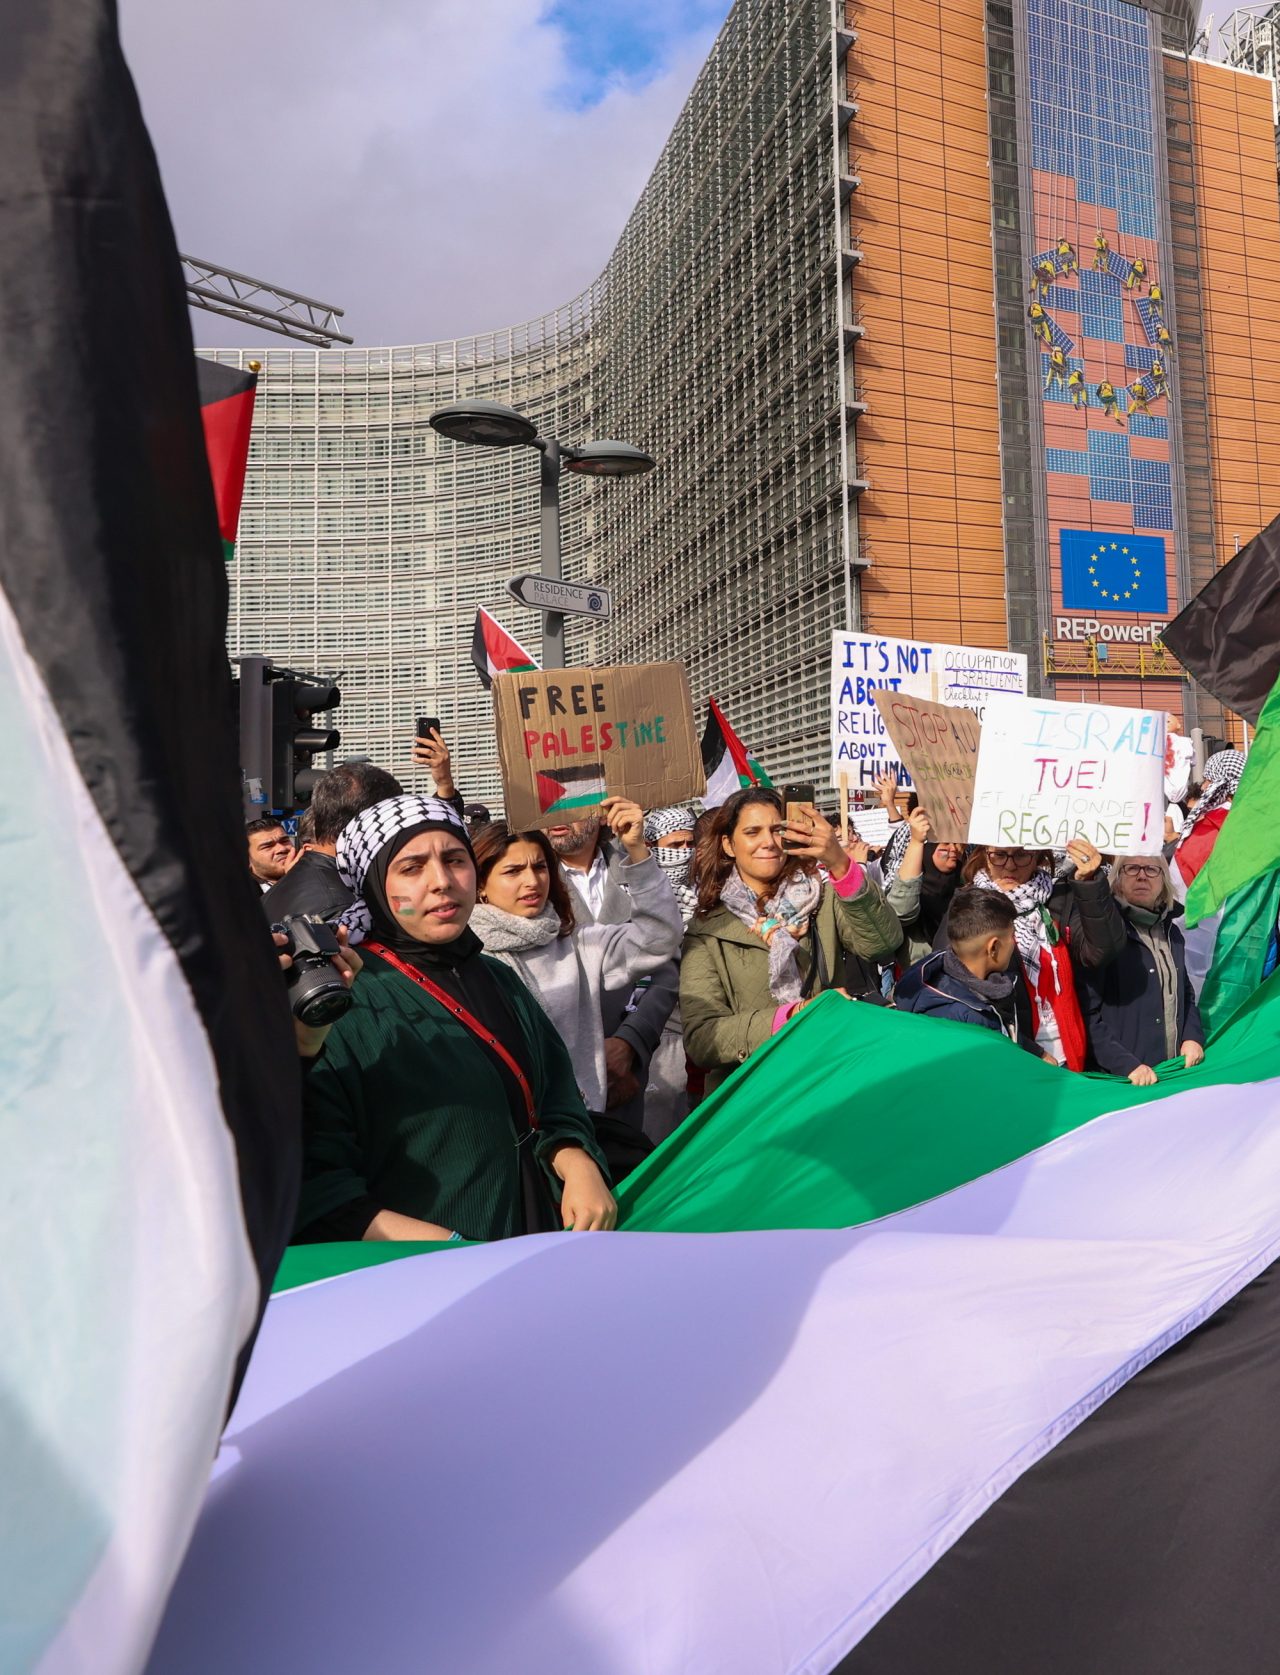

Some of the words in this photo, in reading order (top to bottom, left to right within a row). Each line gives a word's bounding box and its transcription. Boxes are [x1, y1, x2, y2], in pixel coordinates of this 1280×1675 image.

[533, 581, 583, 599] RESIDENCE
[534, 592, 569, 606] PALACE
[1056, 617, 1170, 642] REPowerE
[842, 641, 889, 672] IT'S
[897, 645, 932, 674] NOT
[945, 651, 1017, 671] OCCUPATION
[518, 683, 606, 719] FREE
[891, 703, 948, 749] STOP
[838, 741, 887, 760] ABOUT
[1034, 758, 1107, 792] TUE!
[980, 791, 1004, 808] ET
[998, 810, 1133, 848] REGARDE
